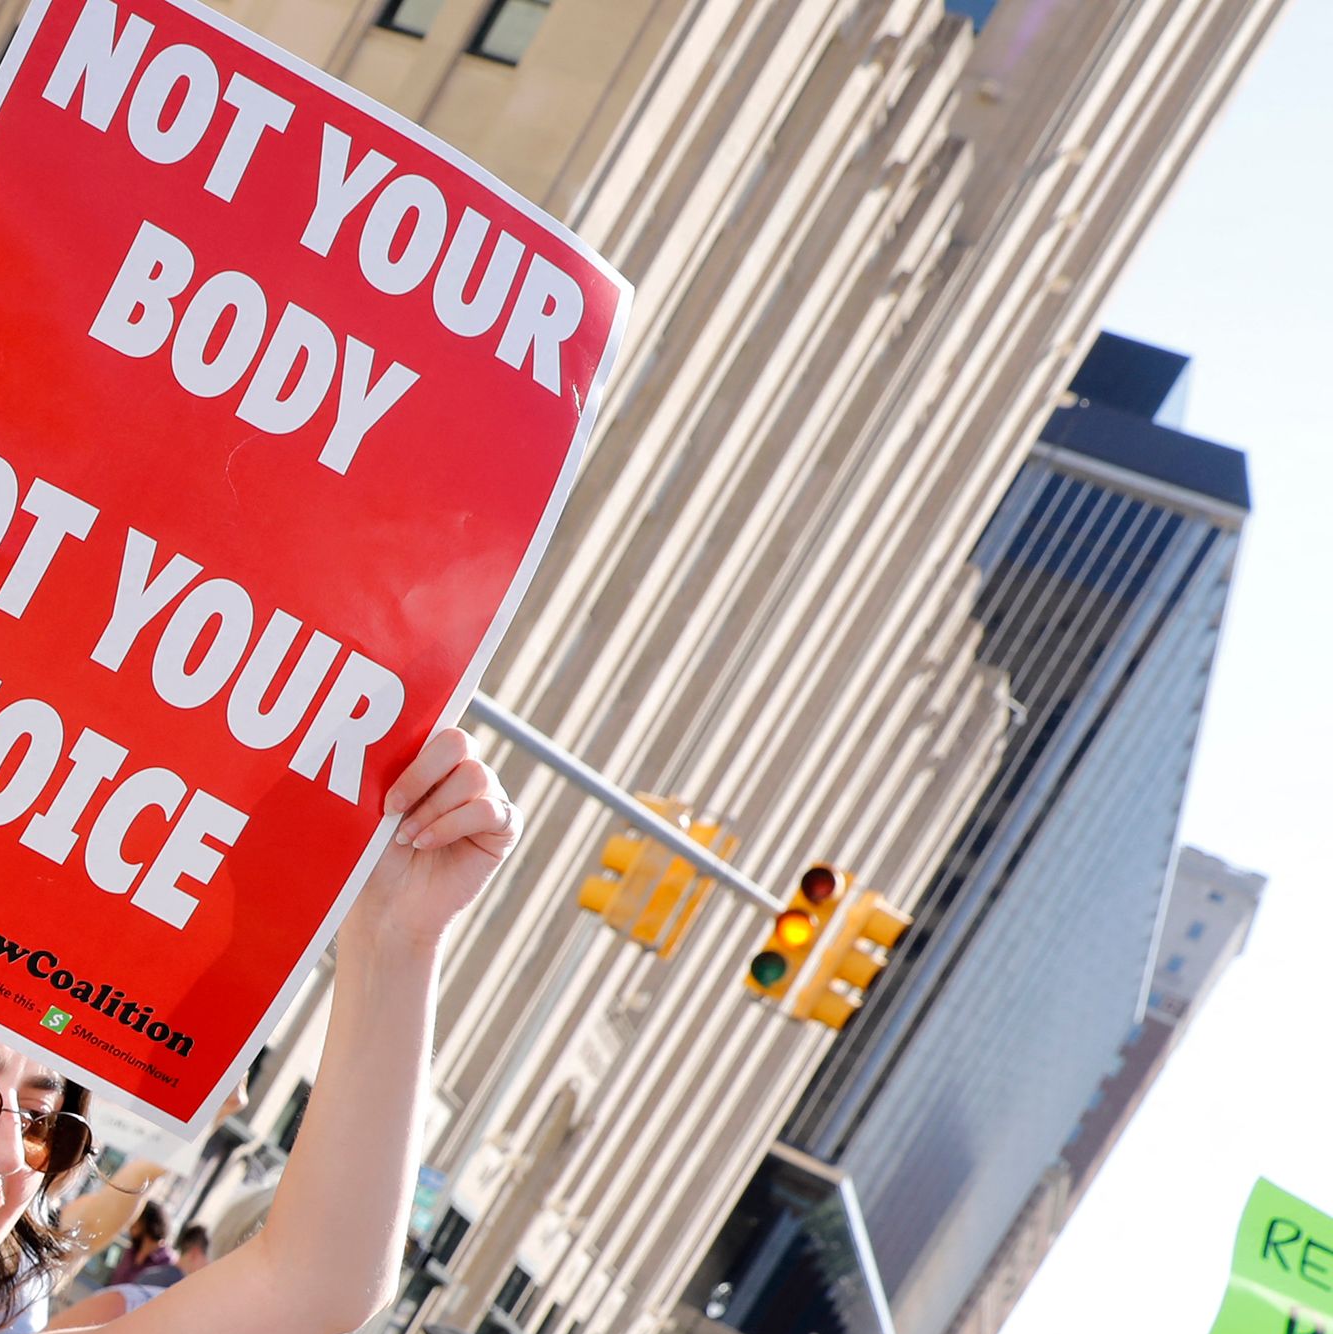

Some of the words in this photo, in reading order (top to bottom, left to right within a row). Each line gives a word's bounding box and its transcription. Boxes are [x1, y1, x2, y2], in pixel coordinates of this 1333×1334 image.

[40, 0, 297, 203] NOT
[299, 122, 585, 397] YOUR
[88, 219, 421, 476] BODY
[90, 526, 405, 805] YOUR
[13, 993, 36, 1011] this
[72, 1023, 180, 1088] $MoratoriumNow1
